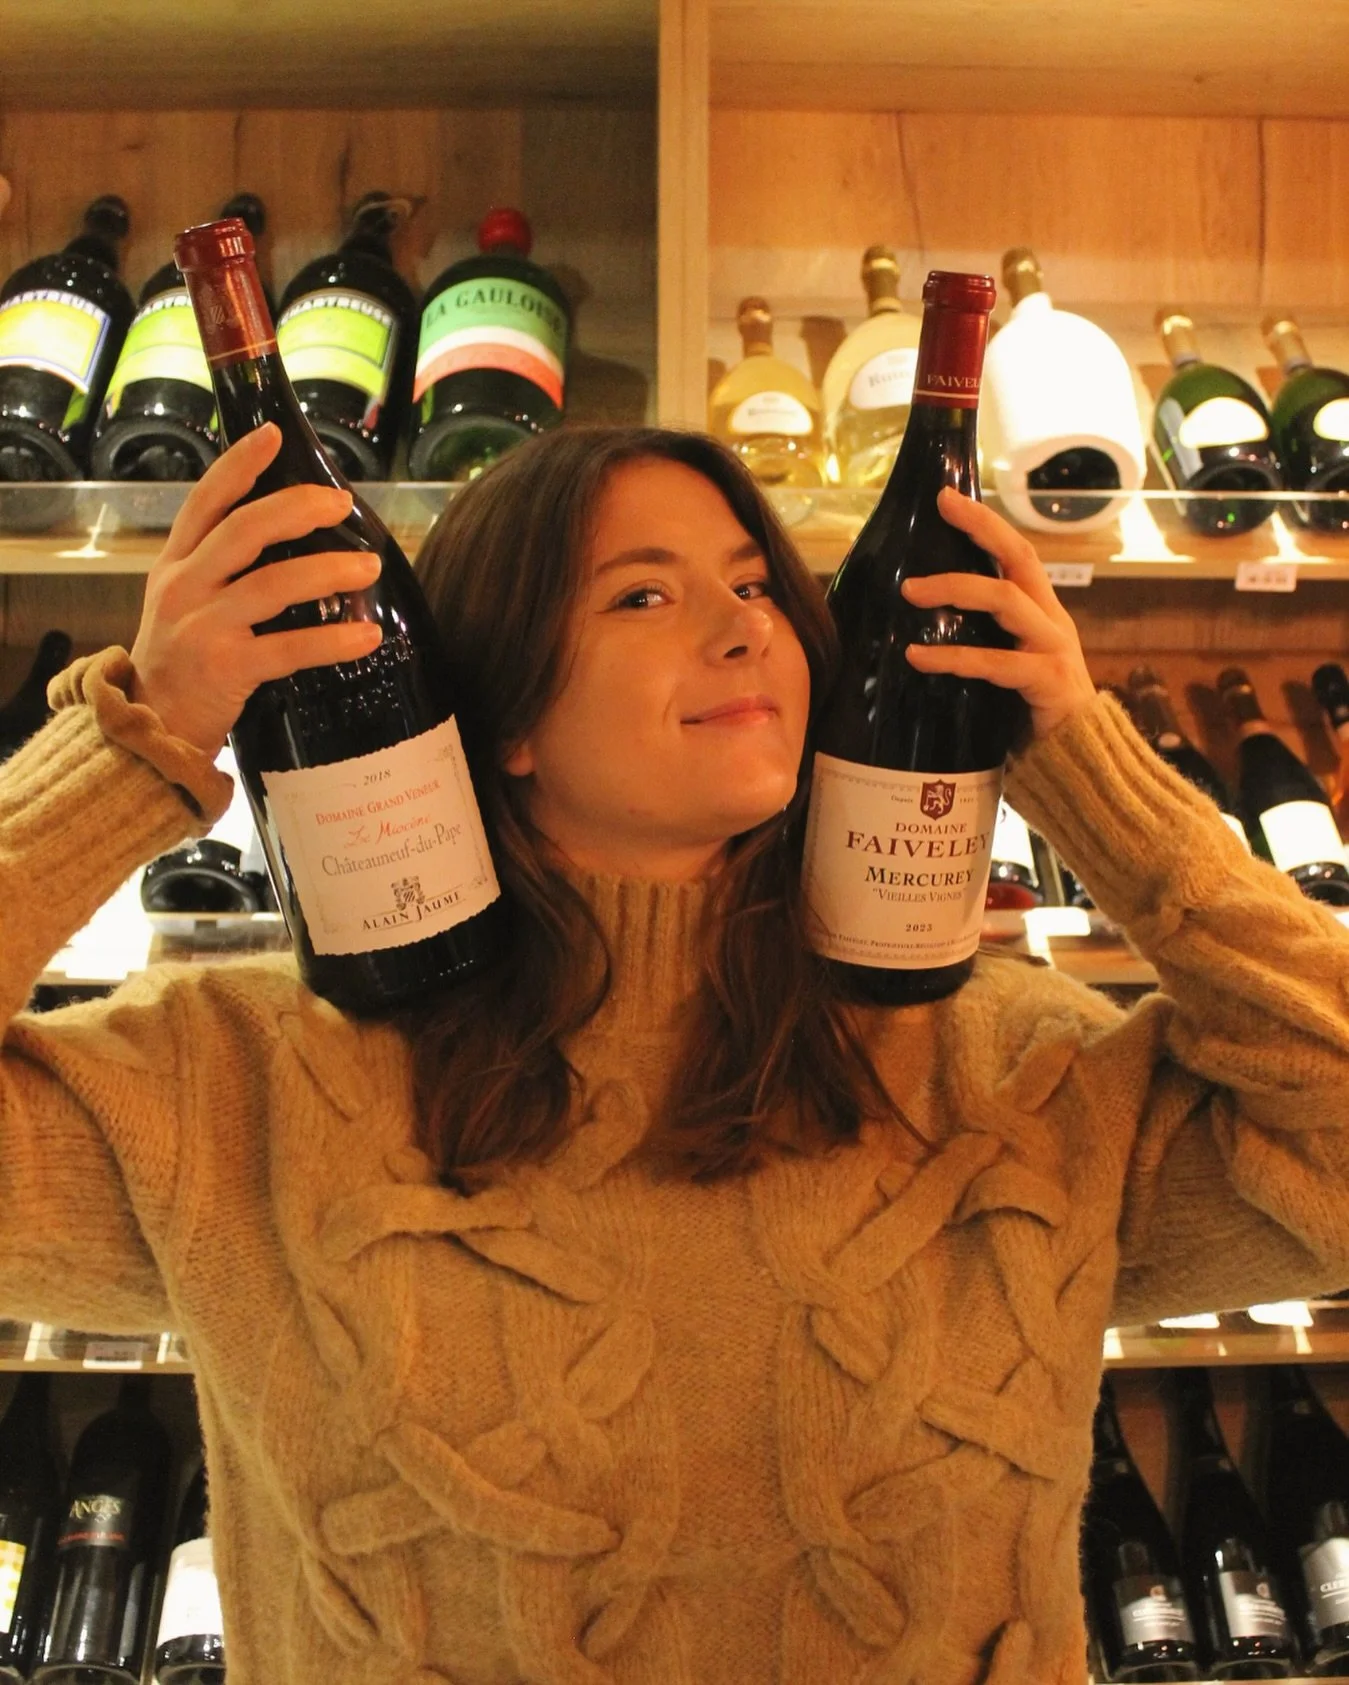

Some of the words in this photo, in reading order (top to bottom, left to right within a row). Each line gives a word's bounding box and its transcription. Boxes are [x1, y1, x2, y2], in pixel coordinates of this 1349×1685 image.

[427, 302, 446, 328] LA
[363, 768, 392, 786] 2018
[315, 806, 364, 825] DOMAINE
[366, 794, 404, 813] GRAND
[404, 779, 441, 800] VENEUR
[895, 822, 967, 835] DOMAINE
[846, 830, 990, 859] FAIVELEY
[864, 865, 975, 887] MERCUREY
[362, 910, 410, 931] ALAIN
[416, 891, 461, 921] JAUME
